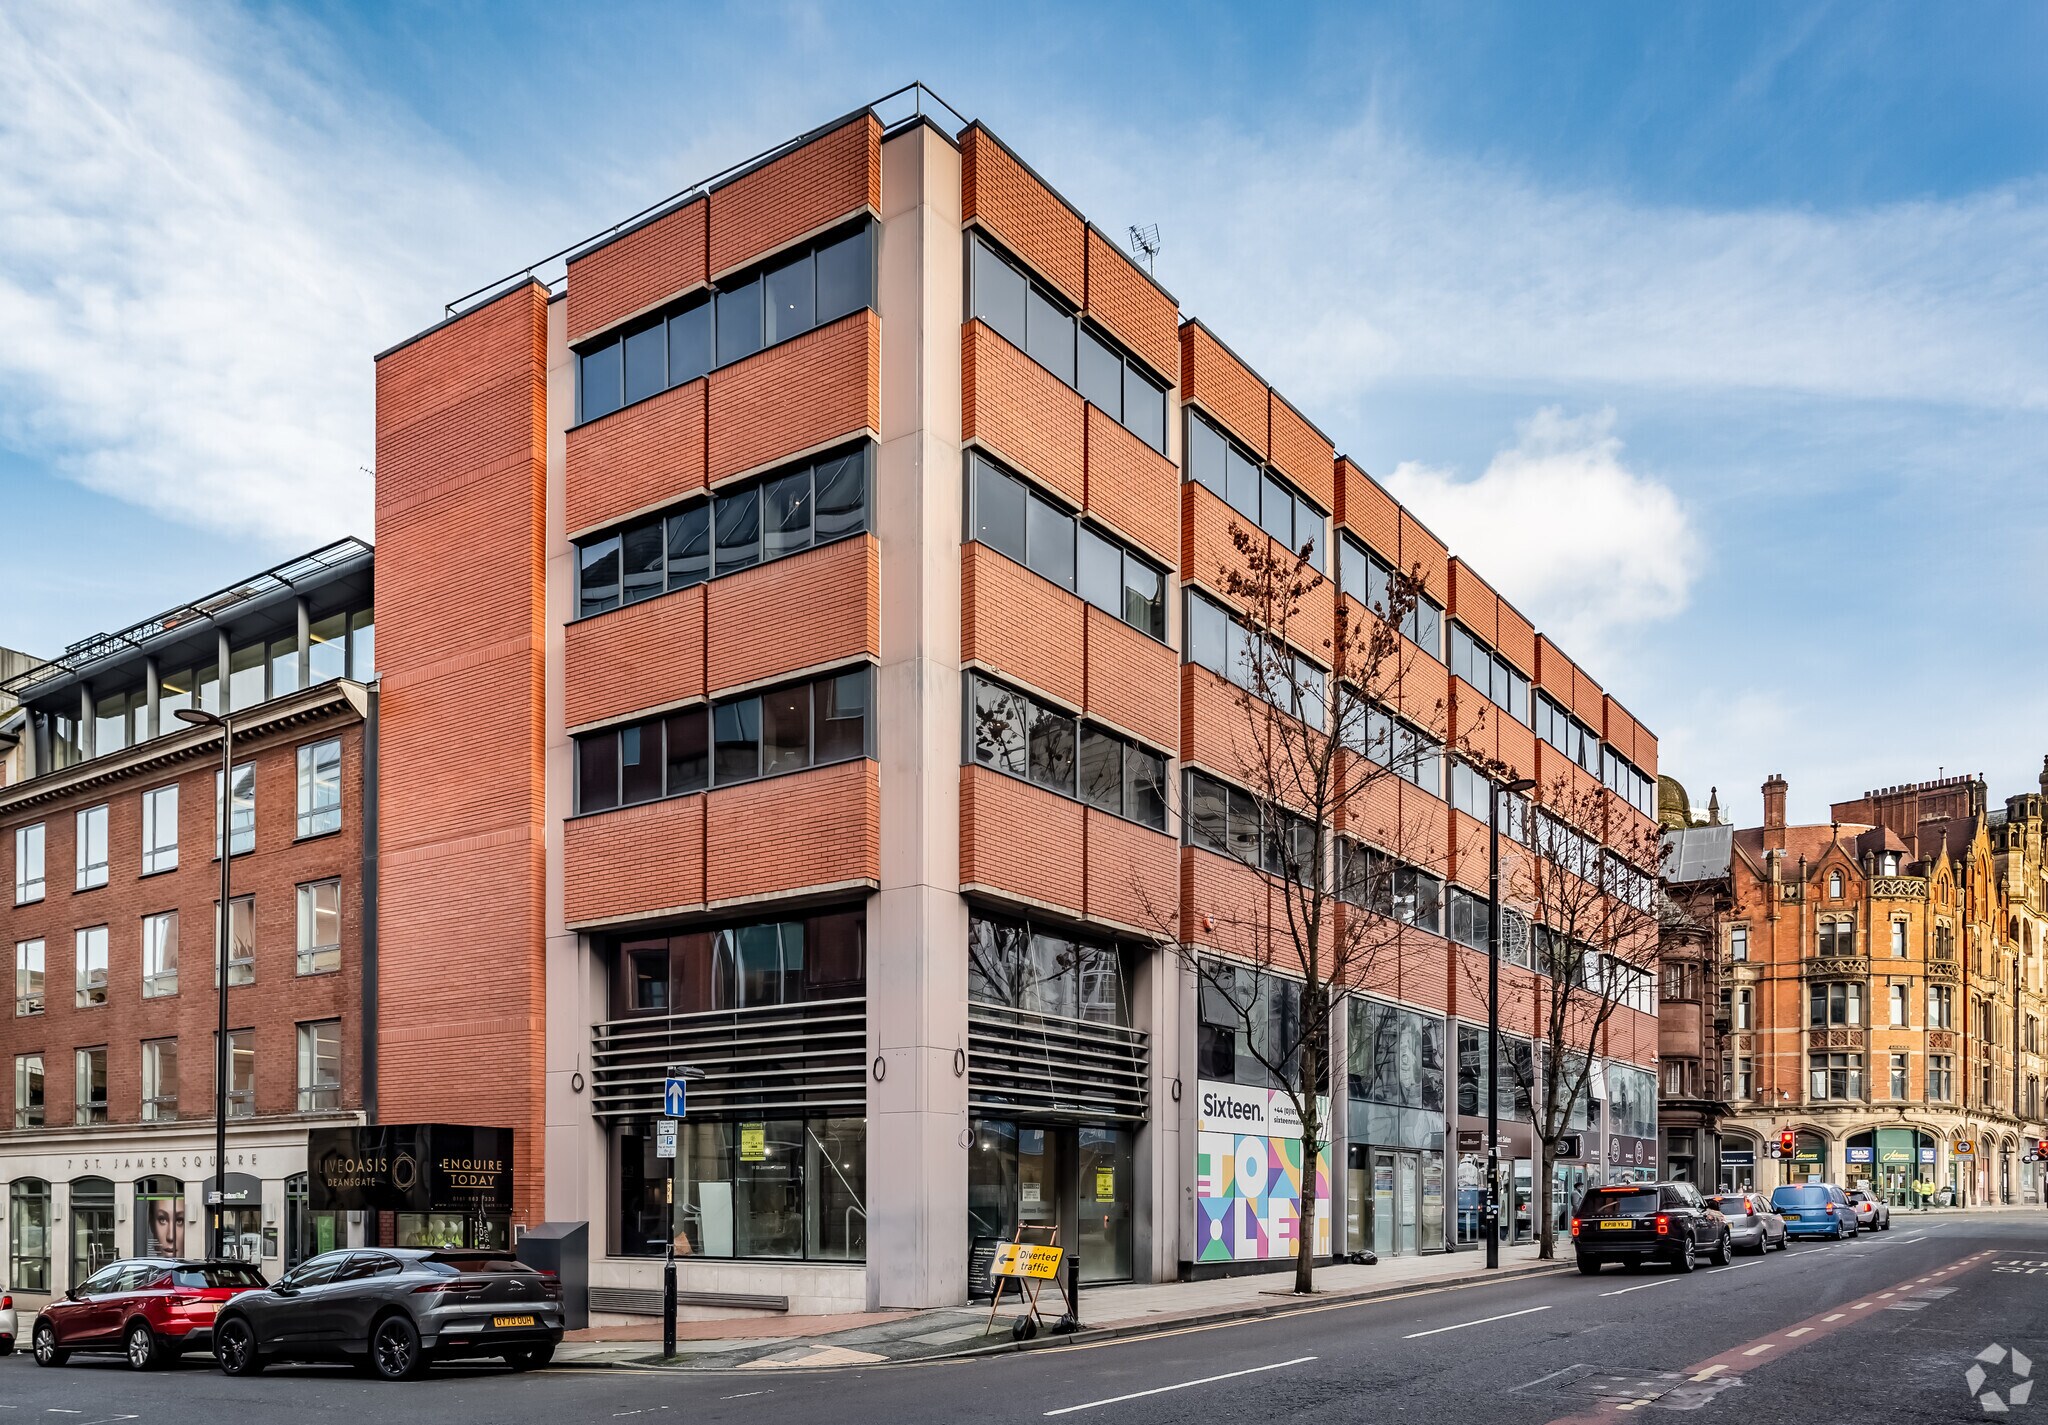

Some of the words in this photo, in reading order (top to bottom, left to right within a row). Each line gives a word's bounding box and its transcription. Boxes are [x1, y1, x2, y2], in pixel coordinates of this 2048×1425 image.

[1203, 1092, 1264, 1122] Sixteen.
[68, 1159, 72, 1169] 7
[84, 1159, 102, 1169] ST.
[114, 1157, 168, 1169] JAMES
[182, 1154, 257, 1168] SQUARE
[443, 1158, 503, 1171] ENQUIRE
[327, 1177, 376, 1187] DEANSGATE
[451, 1174, 495, 1186] TODAY
[1019, 1250, 1058, 1263] Diverted
[1020, 1261, 1049, 1273] traffic
